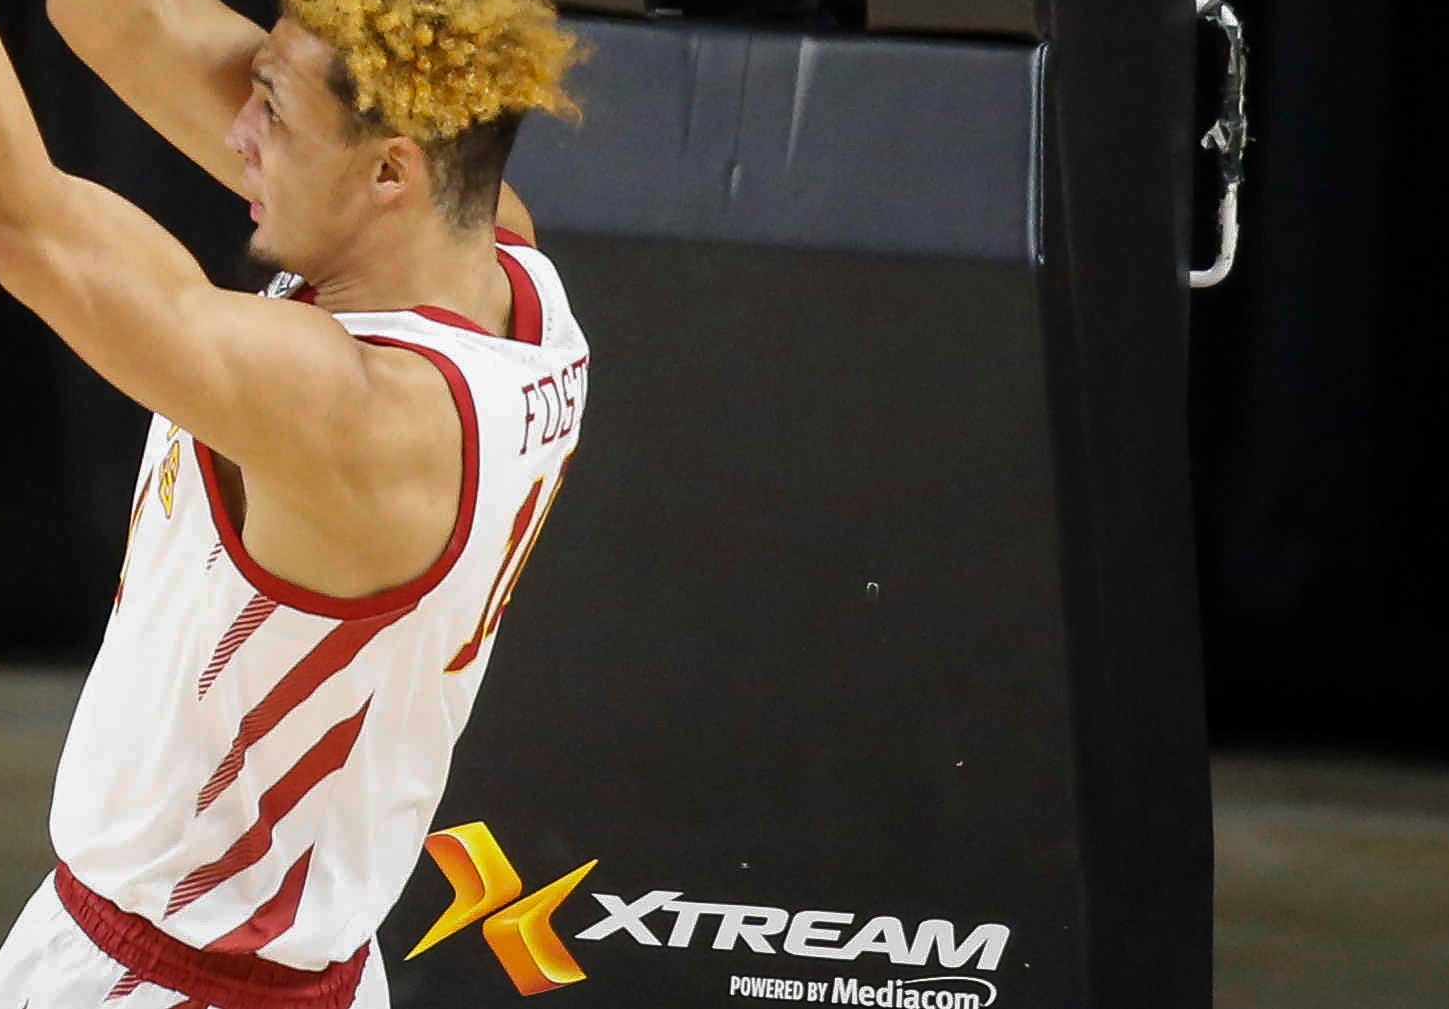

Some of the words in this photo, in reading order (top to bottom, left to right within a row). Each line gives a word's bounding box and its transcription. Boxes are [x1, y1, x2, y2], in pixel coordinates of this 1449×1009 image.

[574, 889, 1011, 971] XTREAM
[729, 975, 803, 1002] POWERED
[806, 980, 829, 1004] BY
[831, 976, 981, 1009] Mediacom
